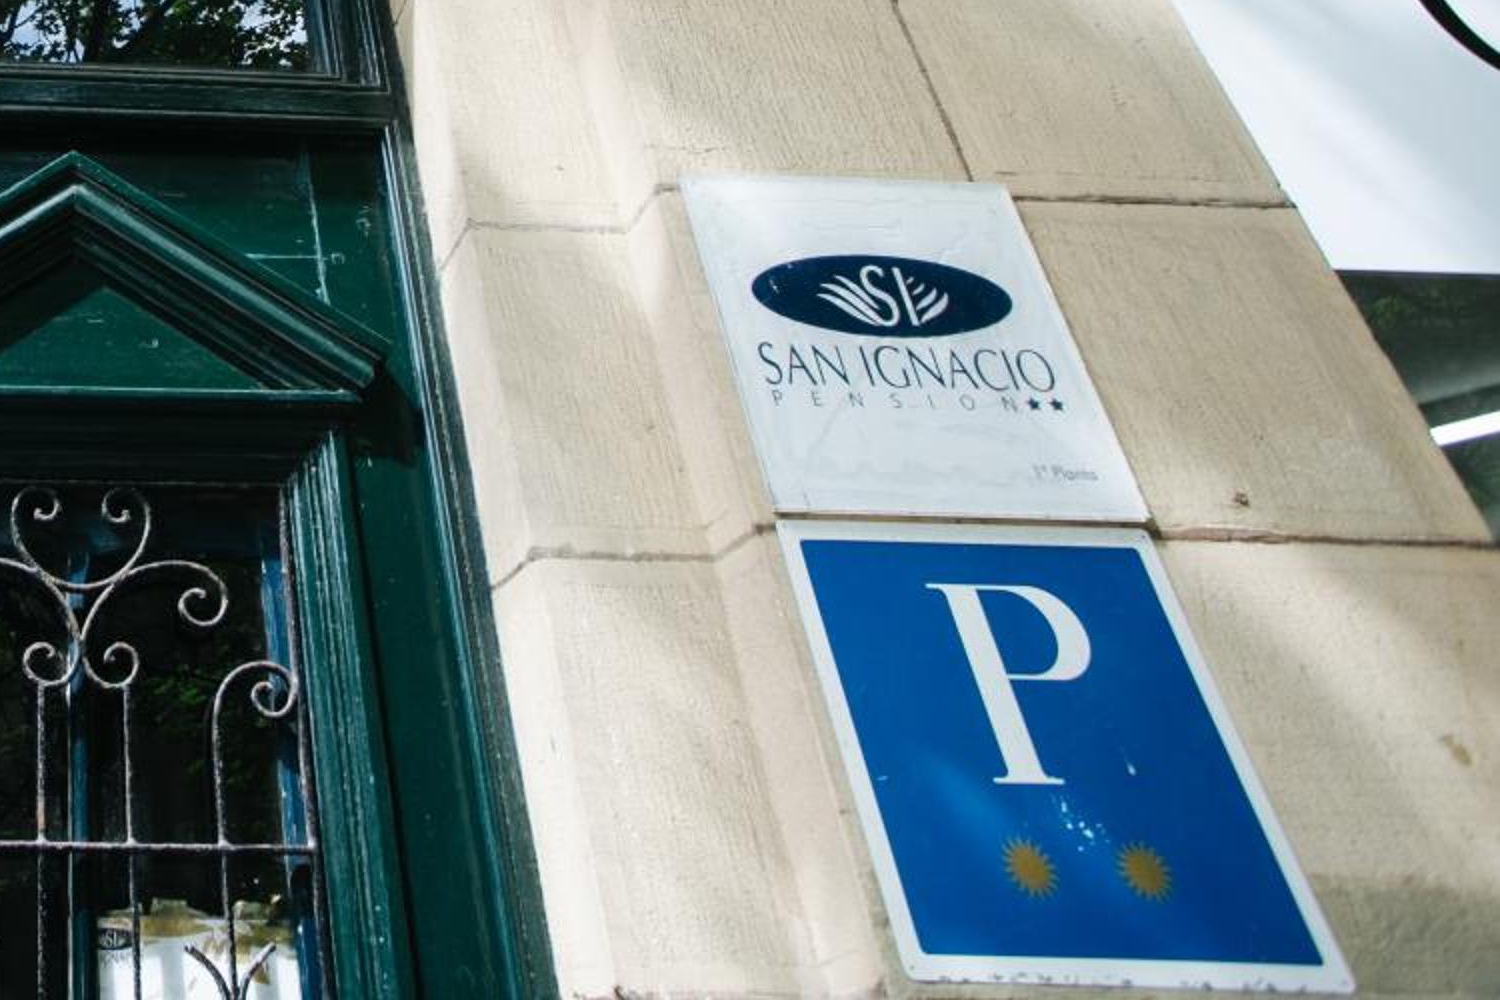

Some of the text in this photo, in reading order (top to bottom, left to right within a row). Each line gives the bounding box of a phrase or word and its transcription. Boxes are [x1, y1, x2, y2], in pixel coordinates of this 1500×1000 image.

[757, 342, 1056, 392] SAN IGNACIO
[924, 582, 1093, 786] P
